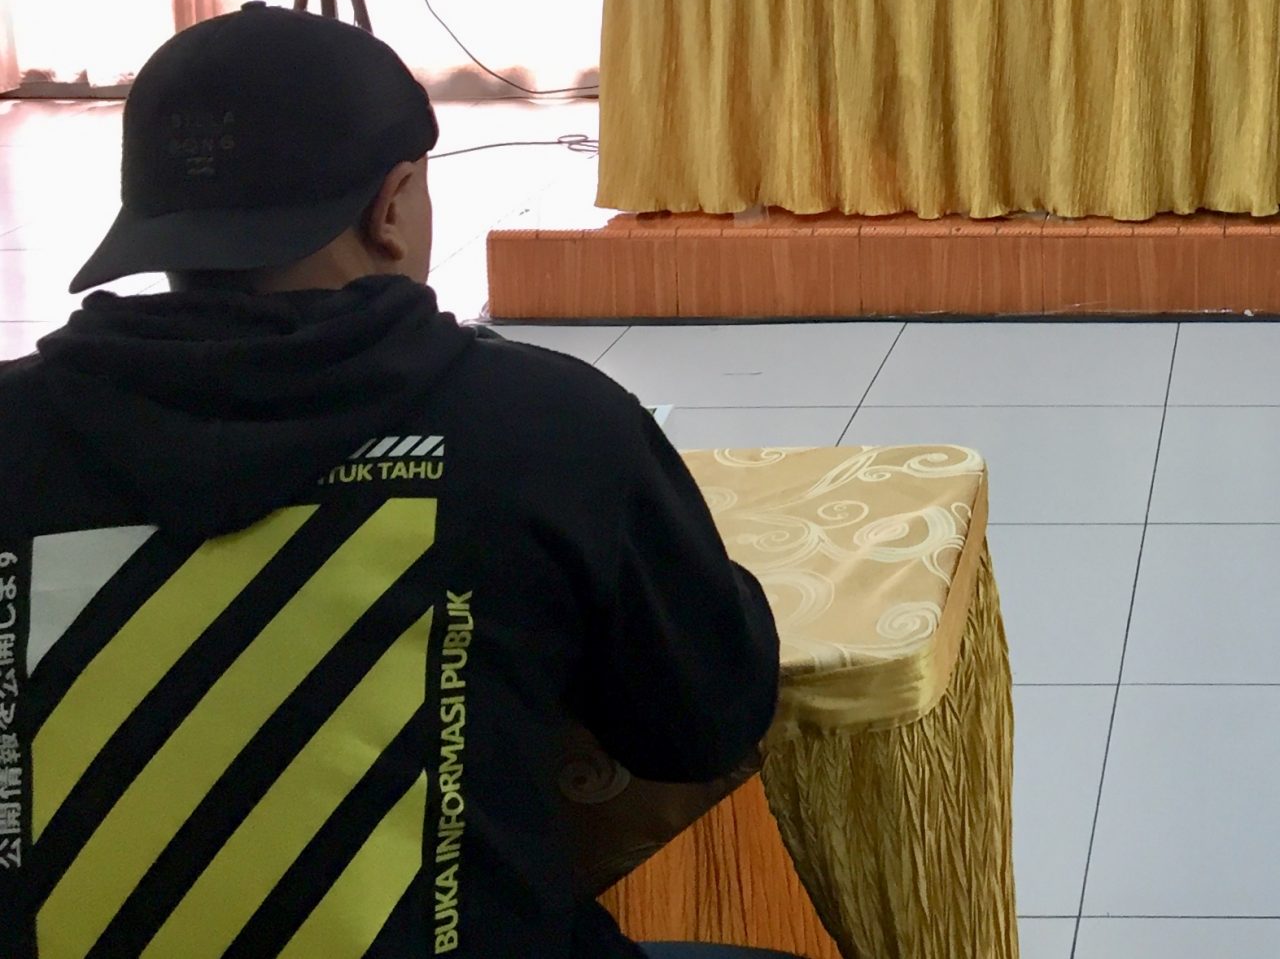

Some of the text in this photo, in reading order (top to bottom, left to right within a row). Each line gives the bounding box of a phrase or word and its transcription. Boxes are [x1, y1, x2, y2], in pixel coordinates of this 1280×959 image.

[317, 460, 444, 485] TUK TAHU
[435, 695, 467, 862] INFORMASI
[434, 864, 460, 955] BUKA
